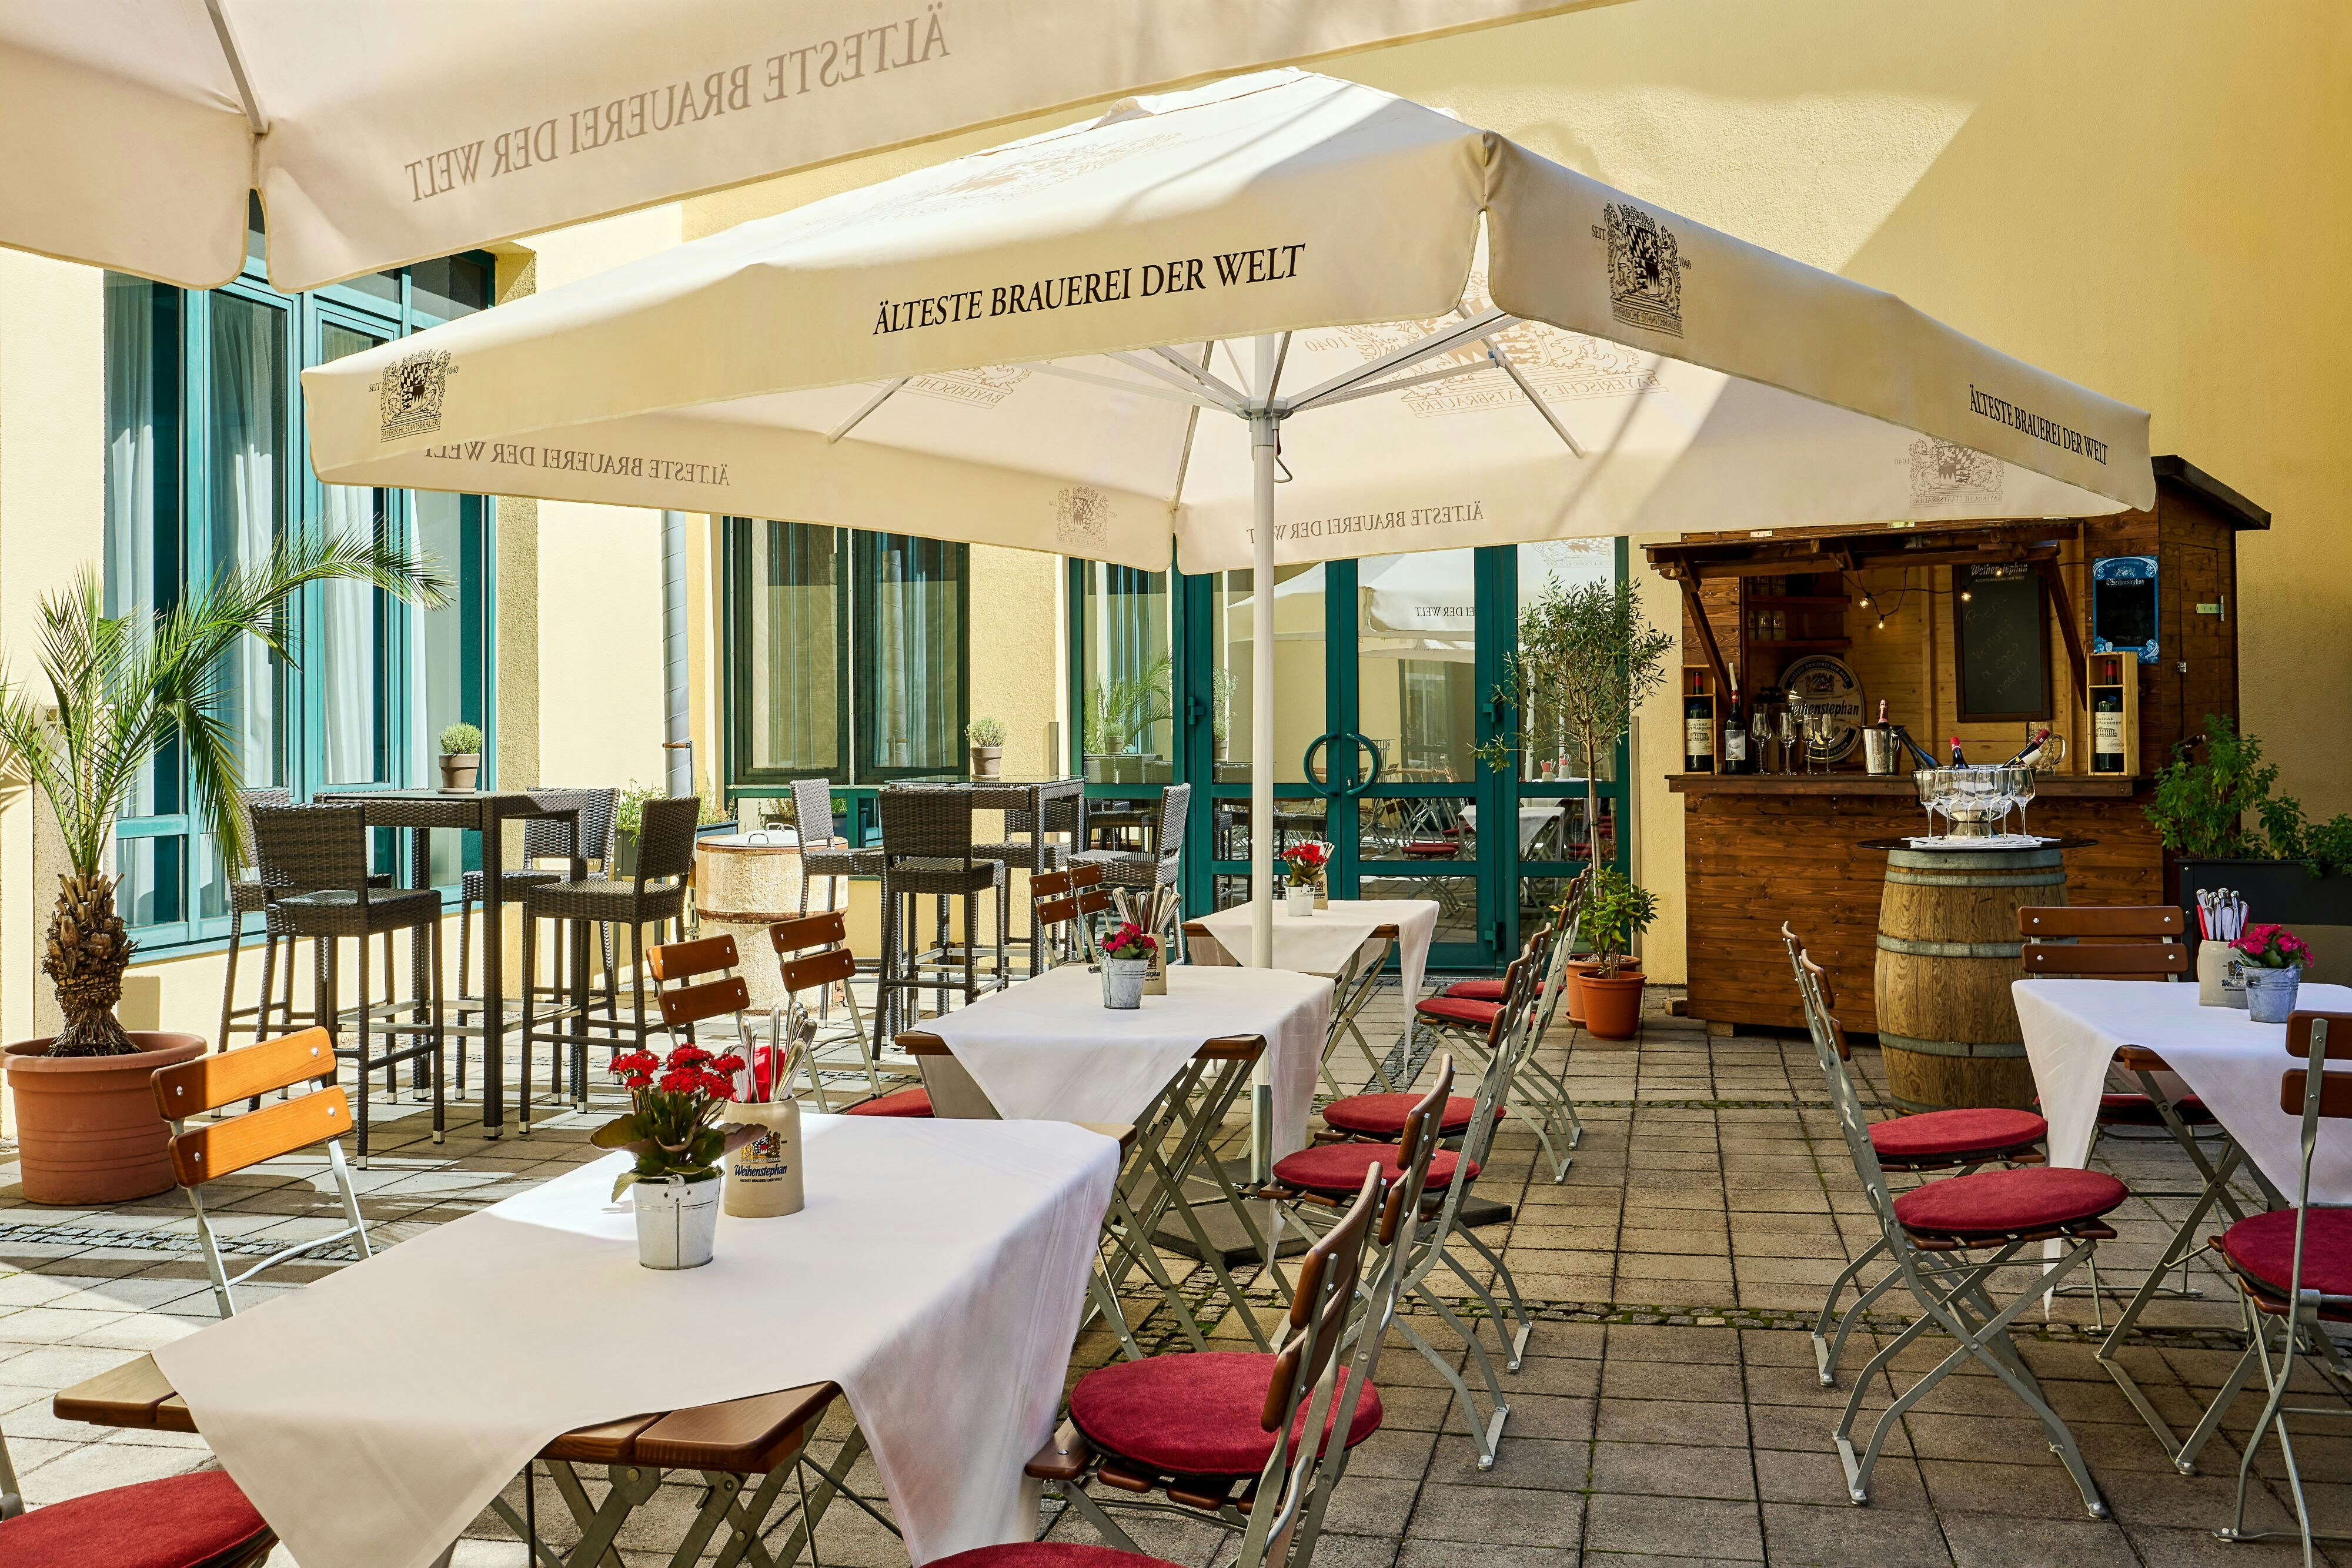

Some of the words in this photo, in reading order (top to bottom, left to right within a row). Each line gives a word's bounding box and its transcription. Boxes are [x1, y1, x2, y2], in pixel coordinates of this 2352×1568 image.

[1591, 225, 1606, 240] SEIT
[1678, 256, 1692, 270] 1040
[873, 290, 983, 336] ÄLTESTE
[989, 268, 1132, 317] BRAUEREI
[1141, 259, 1207, 297] DER
[1213, 243, 1306, 287] WELT
[446, 366, 459, 375] 1040
[369, 382, 381, 392] SEIT
[381, 426, 405, 438] BAYERISCHE
[406, 418, 441, 432] STAATSBRAUEREI
[1969, 384, 2013, 427] ÄLTESTE
[2014, 406, 2062, 447] BRAUEREI
[2063, 427, 2083, 456] DER
[2084, 435, 2108, 465] WELT
[1971, 562, 2028, 576] Weihetephan
[734, 1164, 787, 1177] Weihenstephan
